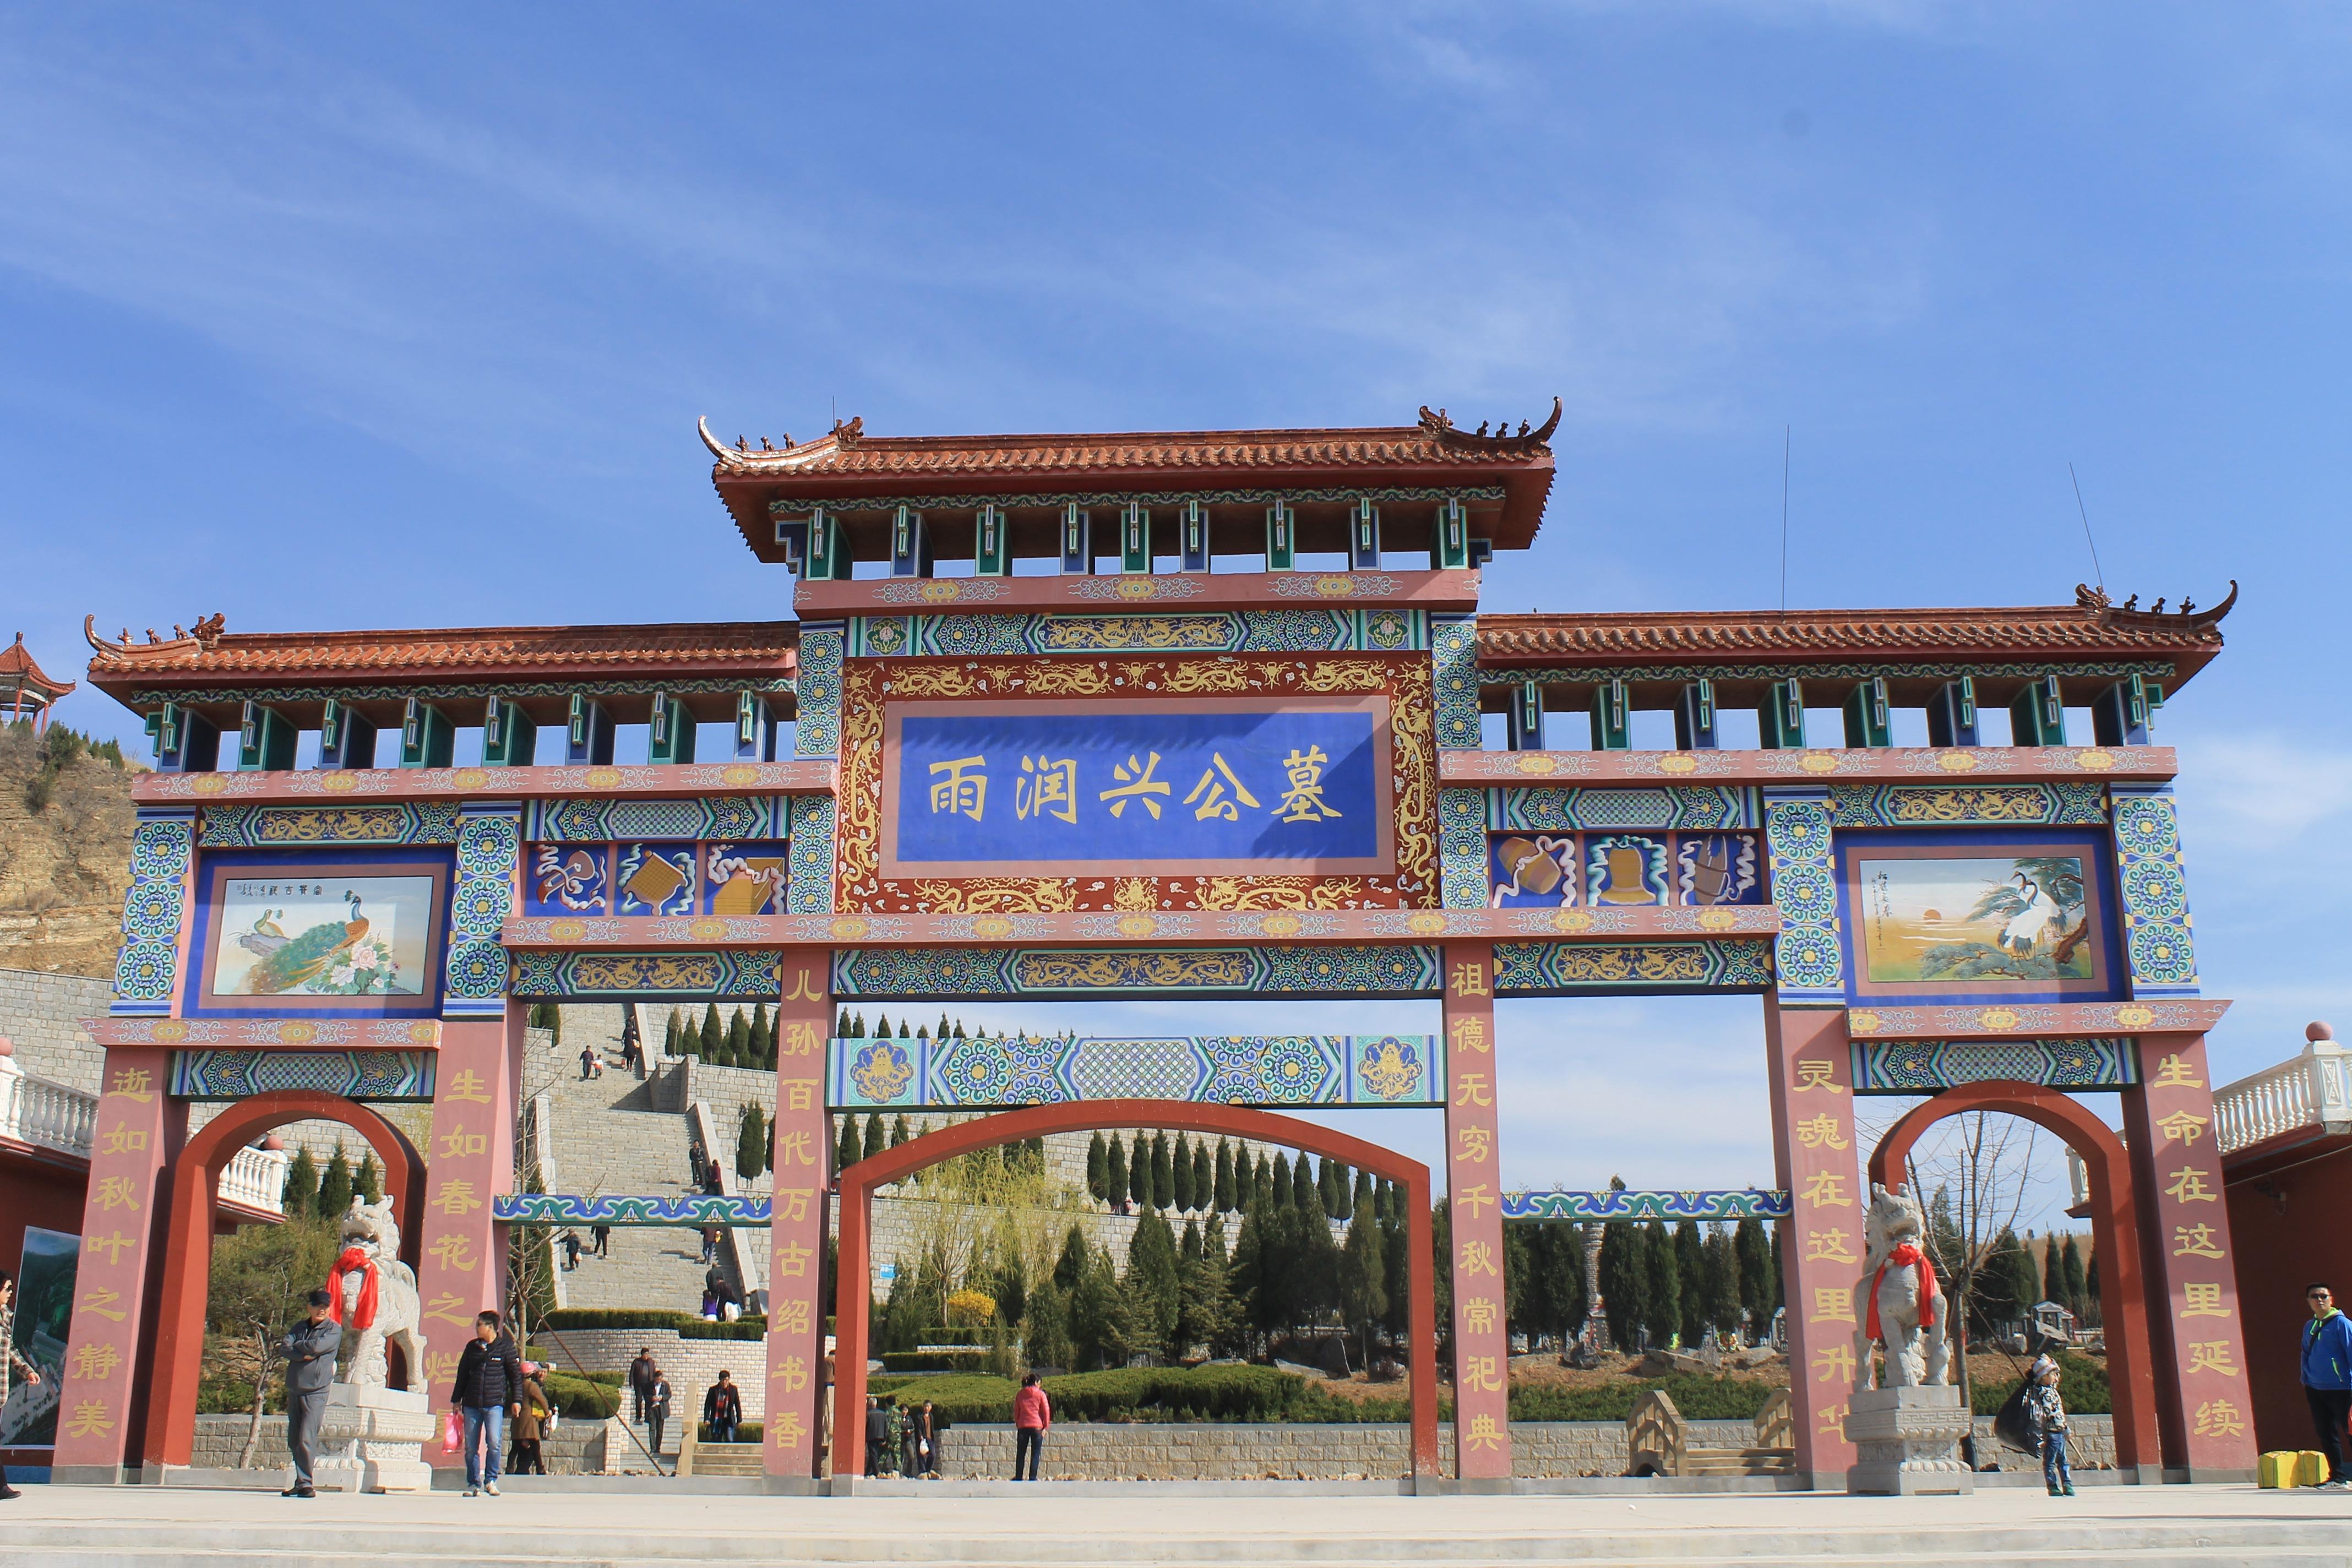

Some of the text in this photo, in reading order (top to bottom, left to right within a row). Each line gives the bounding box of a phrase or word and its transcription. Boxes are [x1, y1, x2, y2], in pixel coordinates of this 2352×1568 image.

[929, 744, 1342, 824] 雨润兴公墓
[65, 1067, 154, 1439] 逝如秋叶之静美
[769, 969, 823, 1450] 儿孙百代万古绍书香
[1450, 963, 1504, 1451] 祖德无穷千秋常祀典
[2153, 1053, 2245, 1438] 生命在这里延续
